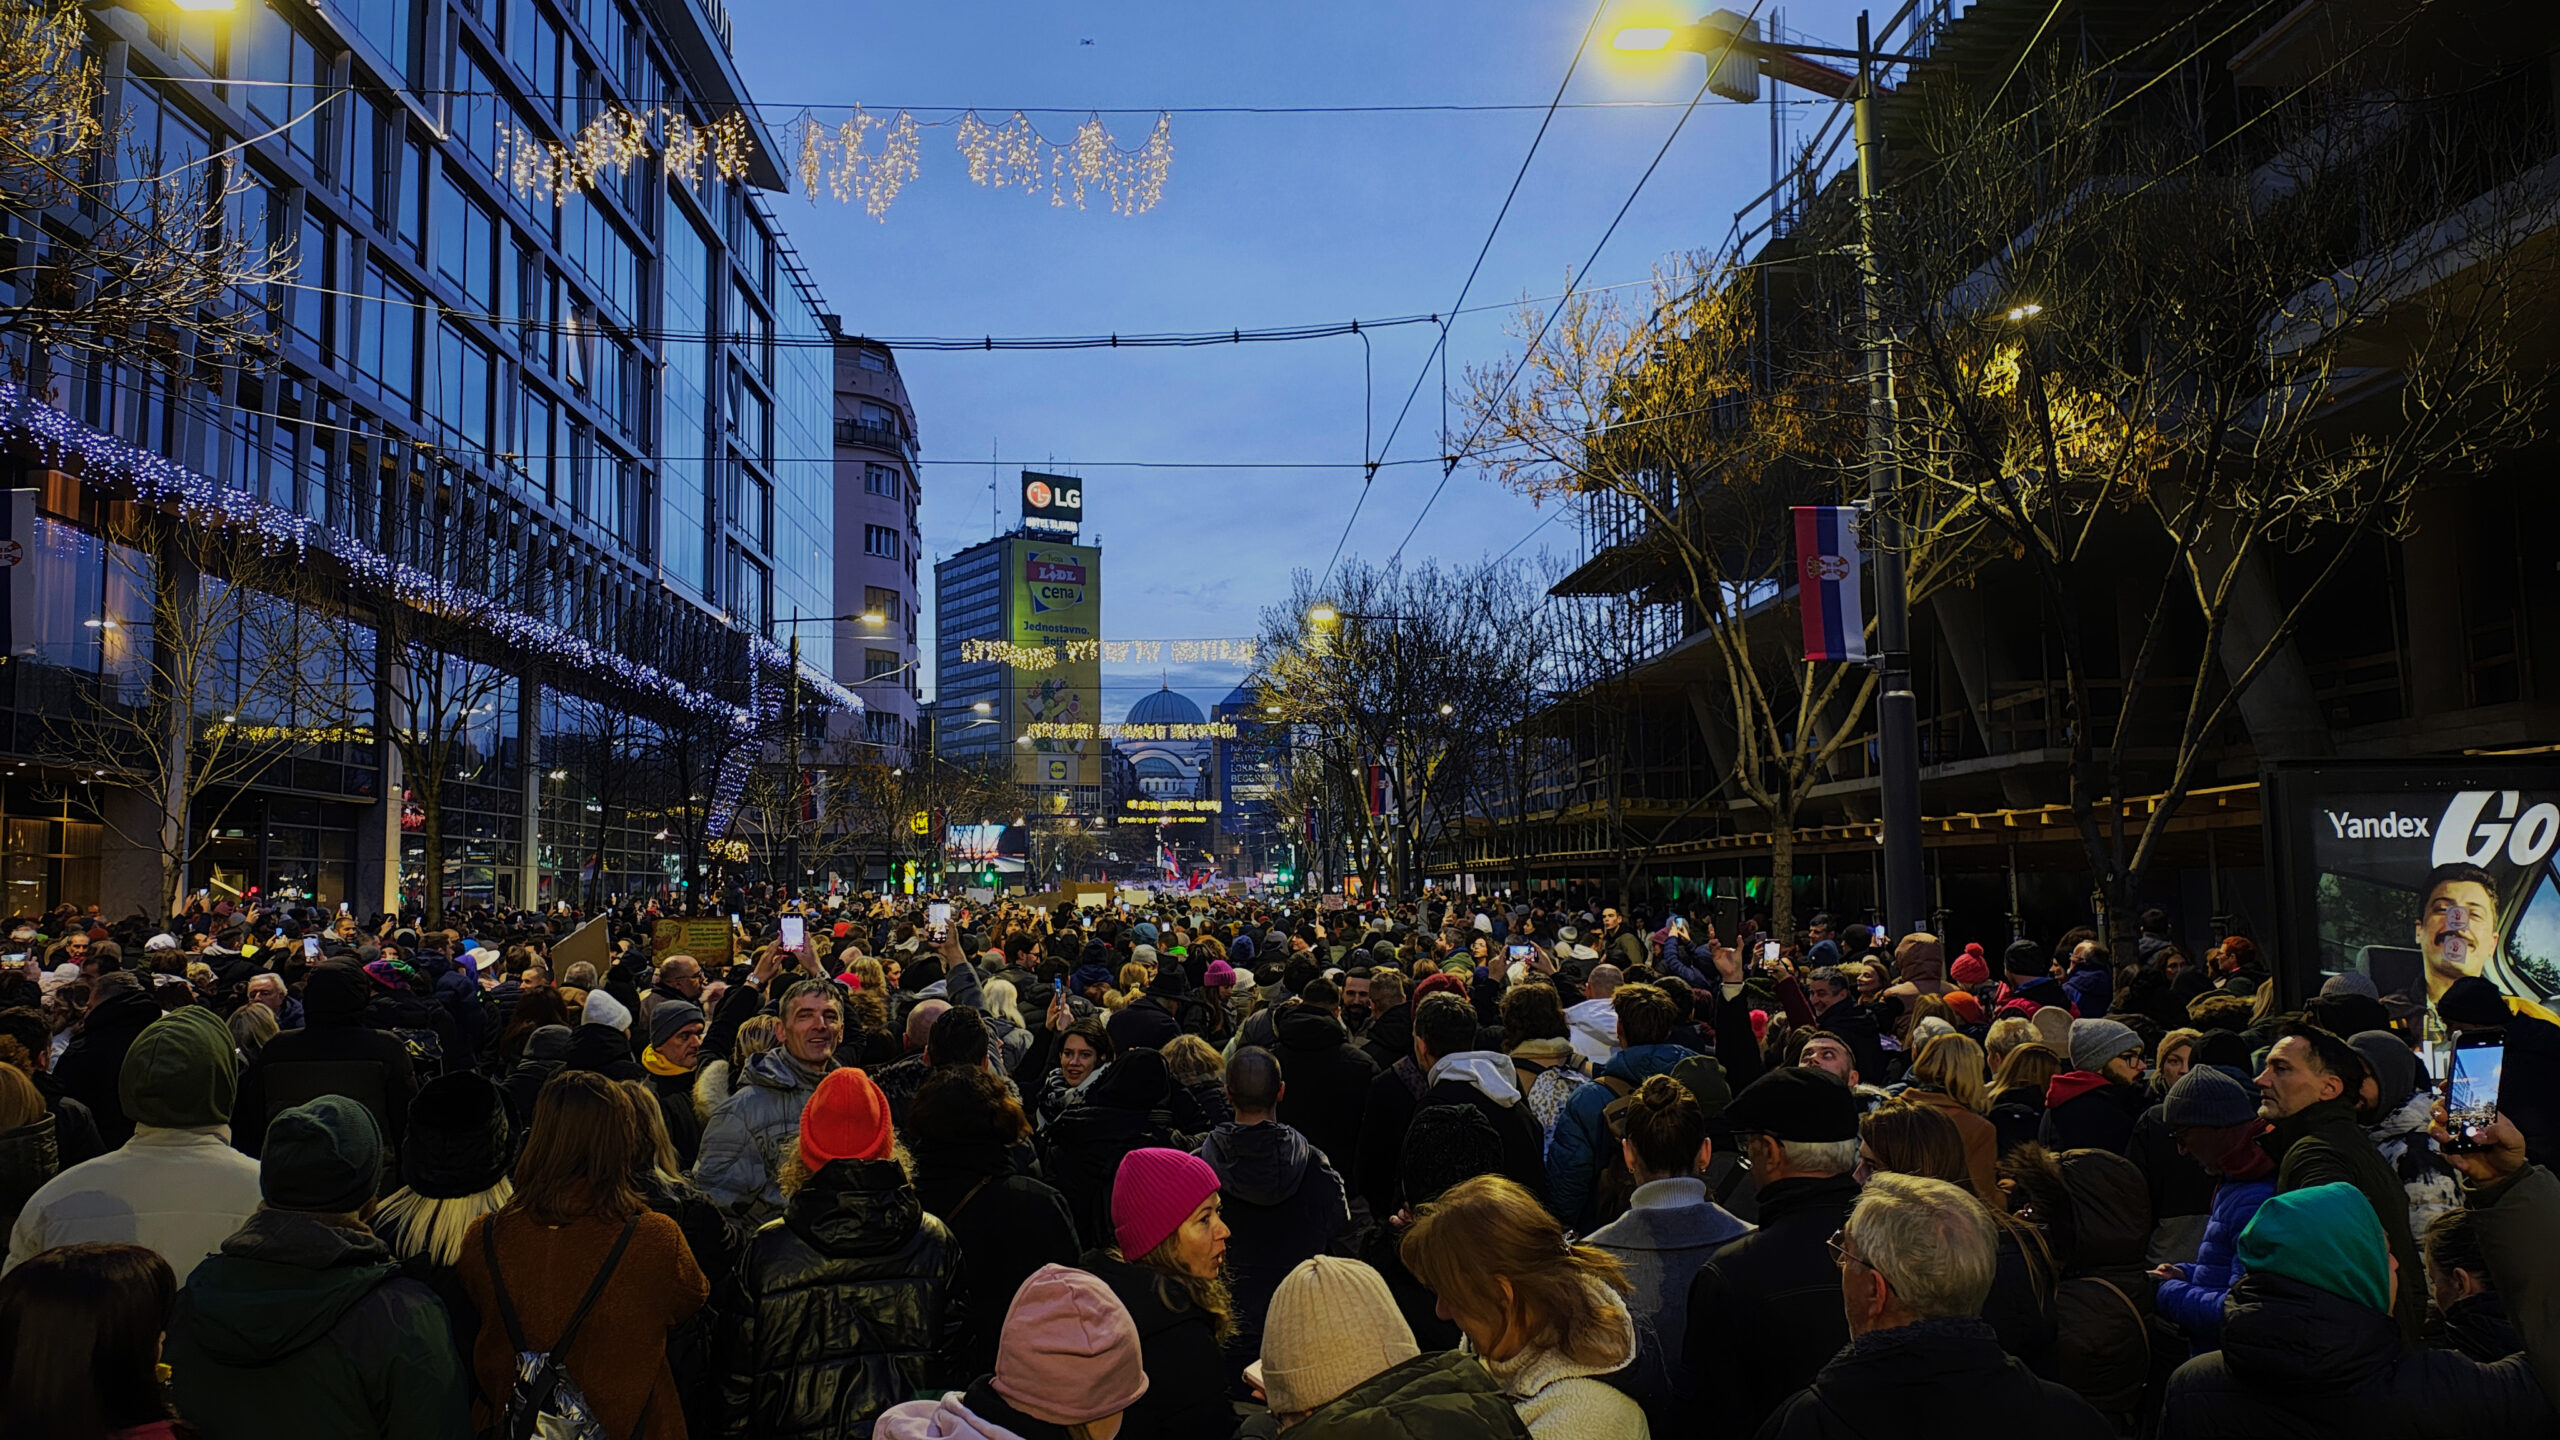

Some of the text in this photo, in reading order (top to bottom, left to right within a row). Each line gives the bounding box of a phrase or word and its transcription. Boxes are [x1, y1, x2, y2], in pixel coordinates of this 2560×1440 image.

[1055, 487, 1081, 508] LG
[1042, 586, 1074, 599] cena
[1023, 621, 1090, 635] Jednostavno.
[2329, 790, 2560, 869] Yandex Go
